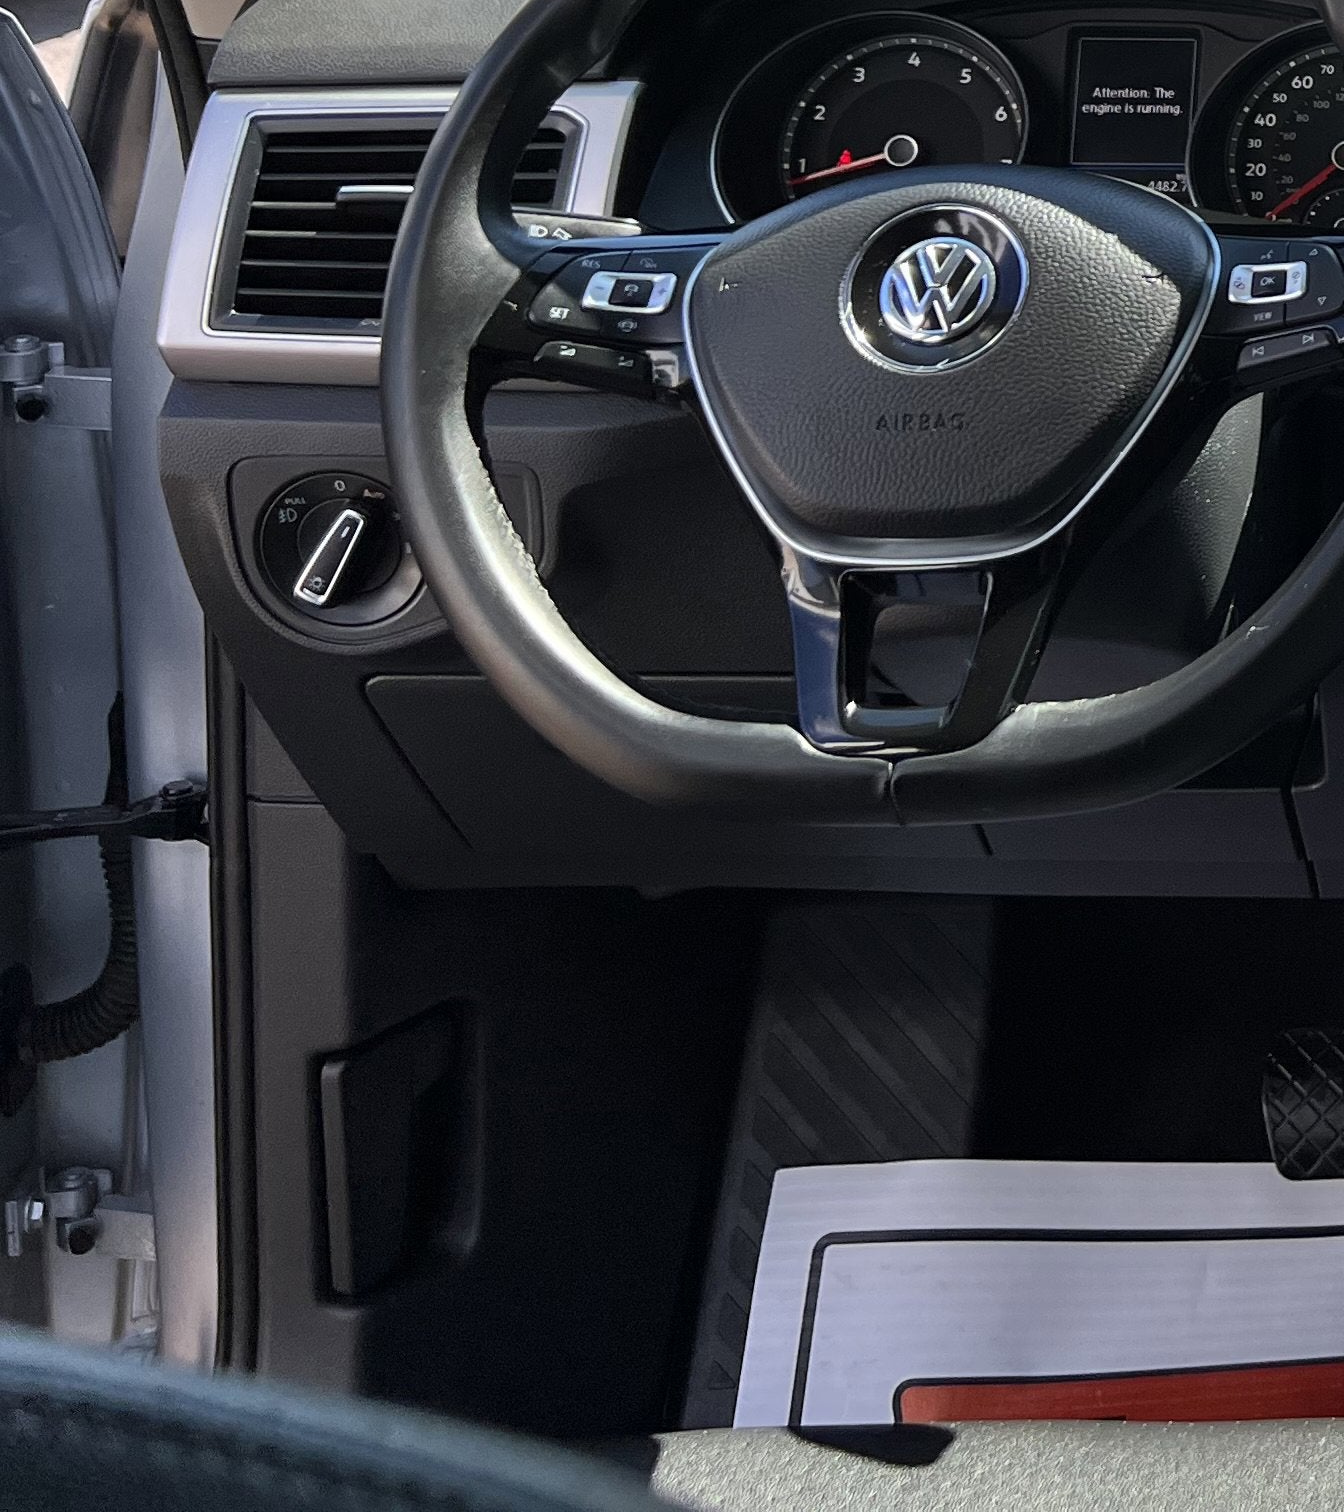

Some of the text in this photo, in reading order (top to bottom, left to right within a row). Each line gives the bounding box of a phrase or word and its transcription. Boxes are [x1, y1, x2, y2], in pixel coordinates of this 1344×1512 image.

[907, 51, 921, 68] 4
[853, 66, 866, 83] 3
[959, 68, 972, 84] 5
[1320, 64, 1335, 75] 70
[1290, 75, 1314, 89] 60
[1092, 87, 1176, 99] Attention: The
[1272, 92, 1288, 103] 50
[1081, 102, 1184, 117] engine is running.
[1312, 100, 1330, 109] 100
[813, 105, 826, 121] 2
[994, 106, 1008, 122] 6
[1253, 113, 1277, 127] 40
[1247, 138, 1262, 149] 30
[799, 158, 806, 174] 1
[1244, 162, 1267, 177] 20
[1251, 191, 1264, 201] 10
[1259, 275, 1277, 287] OK
[549, 306, 571, 320] SET
[1253, 311, 1273, 322] VIEW
[875, 412, 969, 433] AIRBAG
